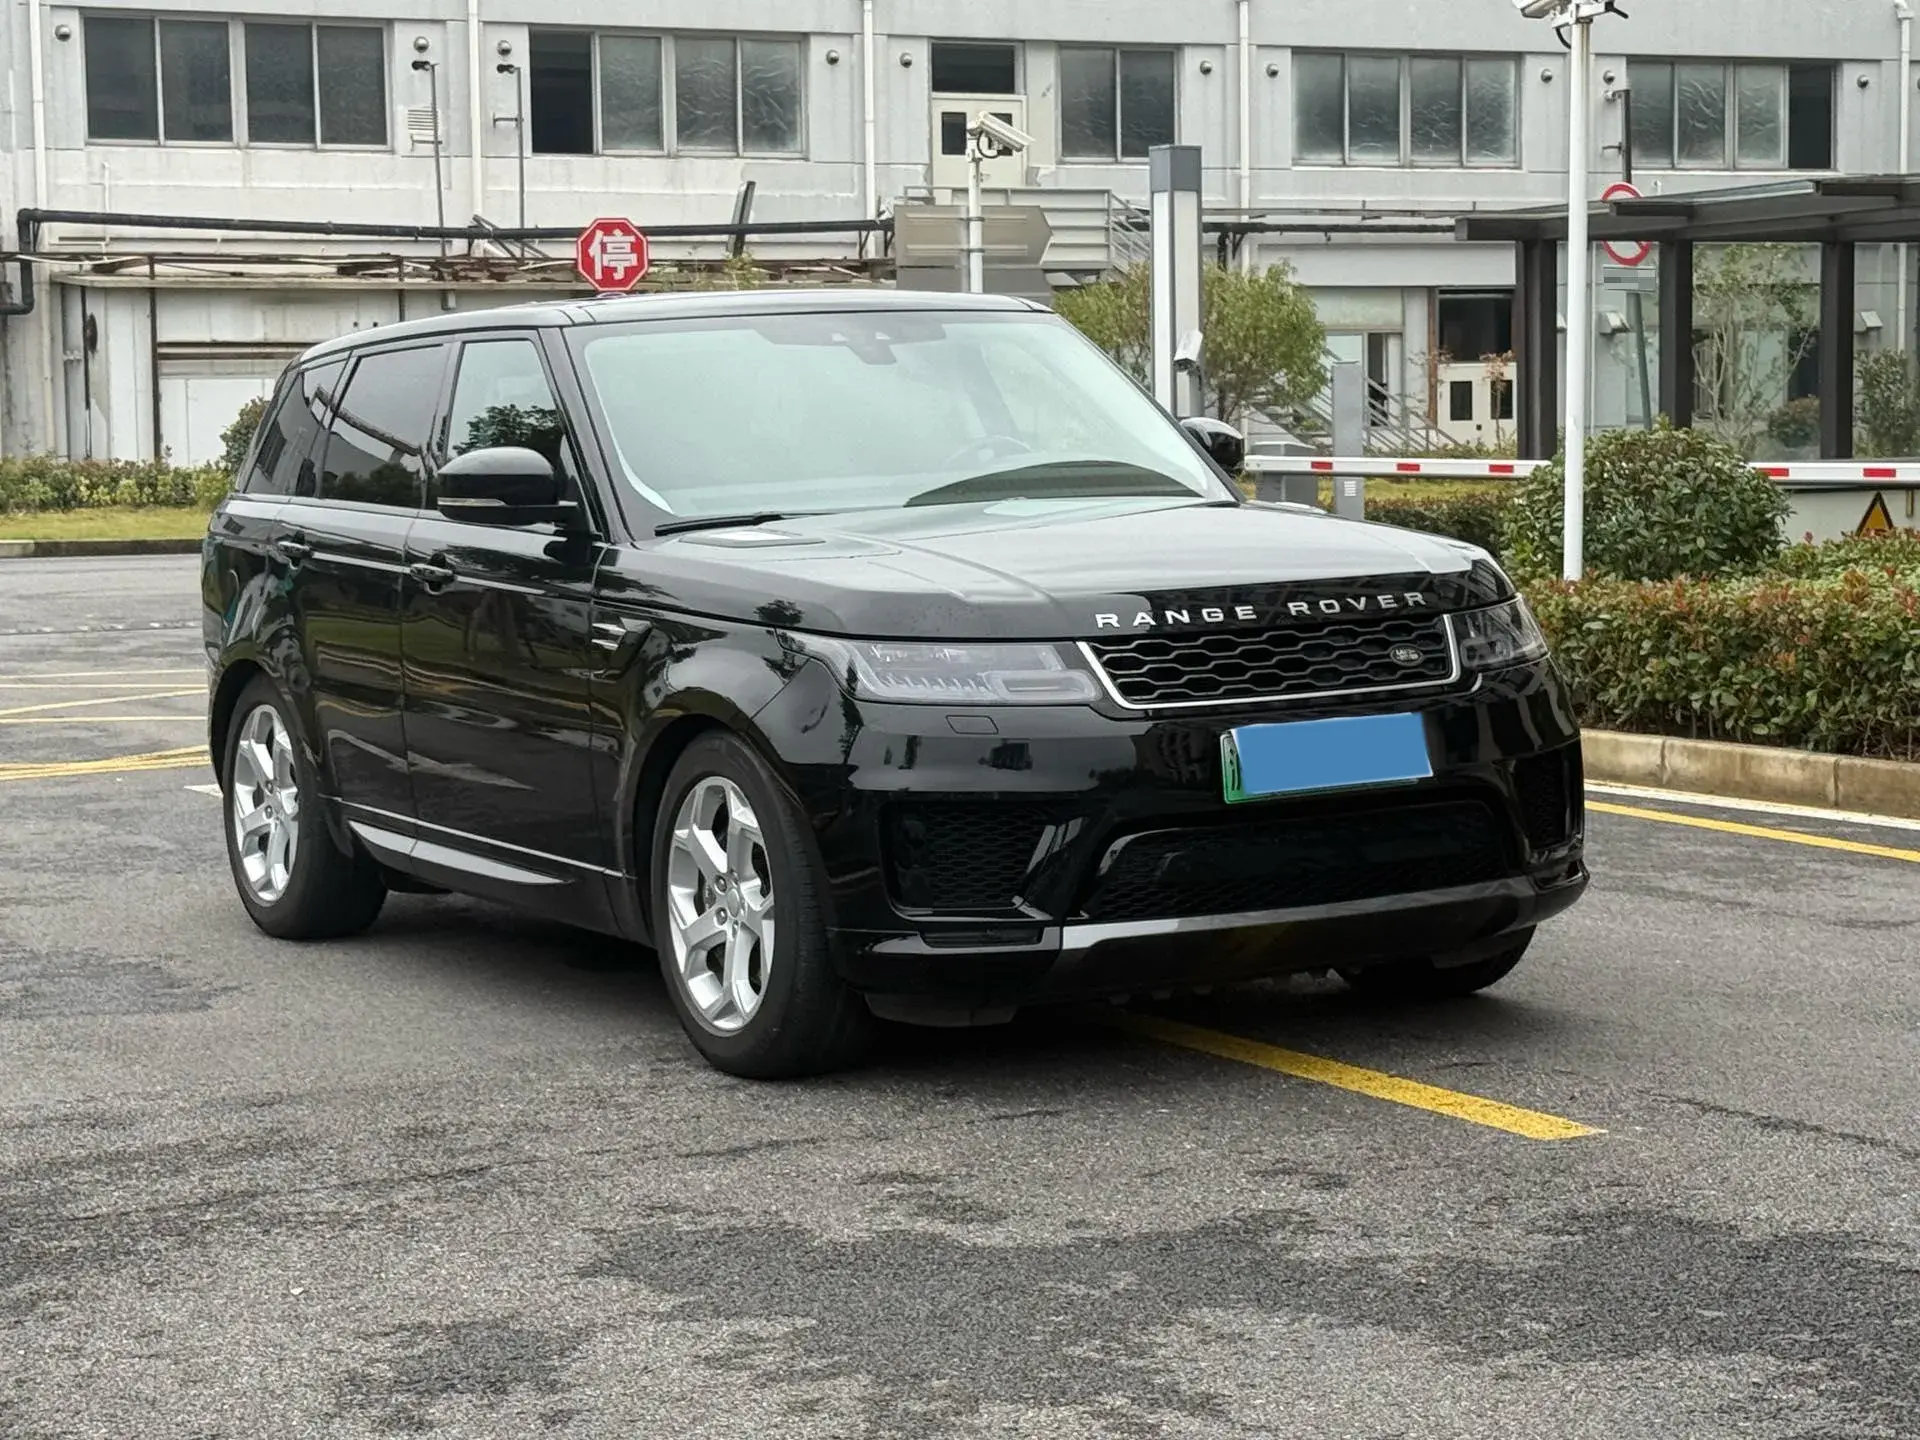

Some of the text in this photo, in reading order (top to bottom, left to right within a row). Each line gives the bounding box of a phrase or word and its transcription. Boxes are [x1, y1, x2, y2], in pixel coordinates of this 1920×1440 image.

[588, 228, 638, 280] 停
[1095, 591, 1427, 629] RANGE ROVER
